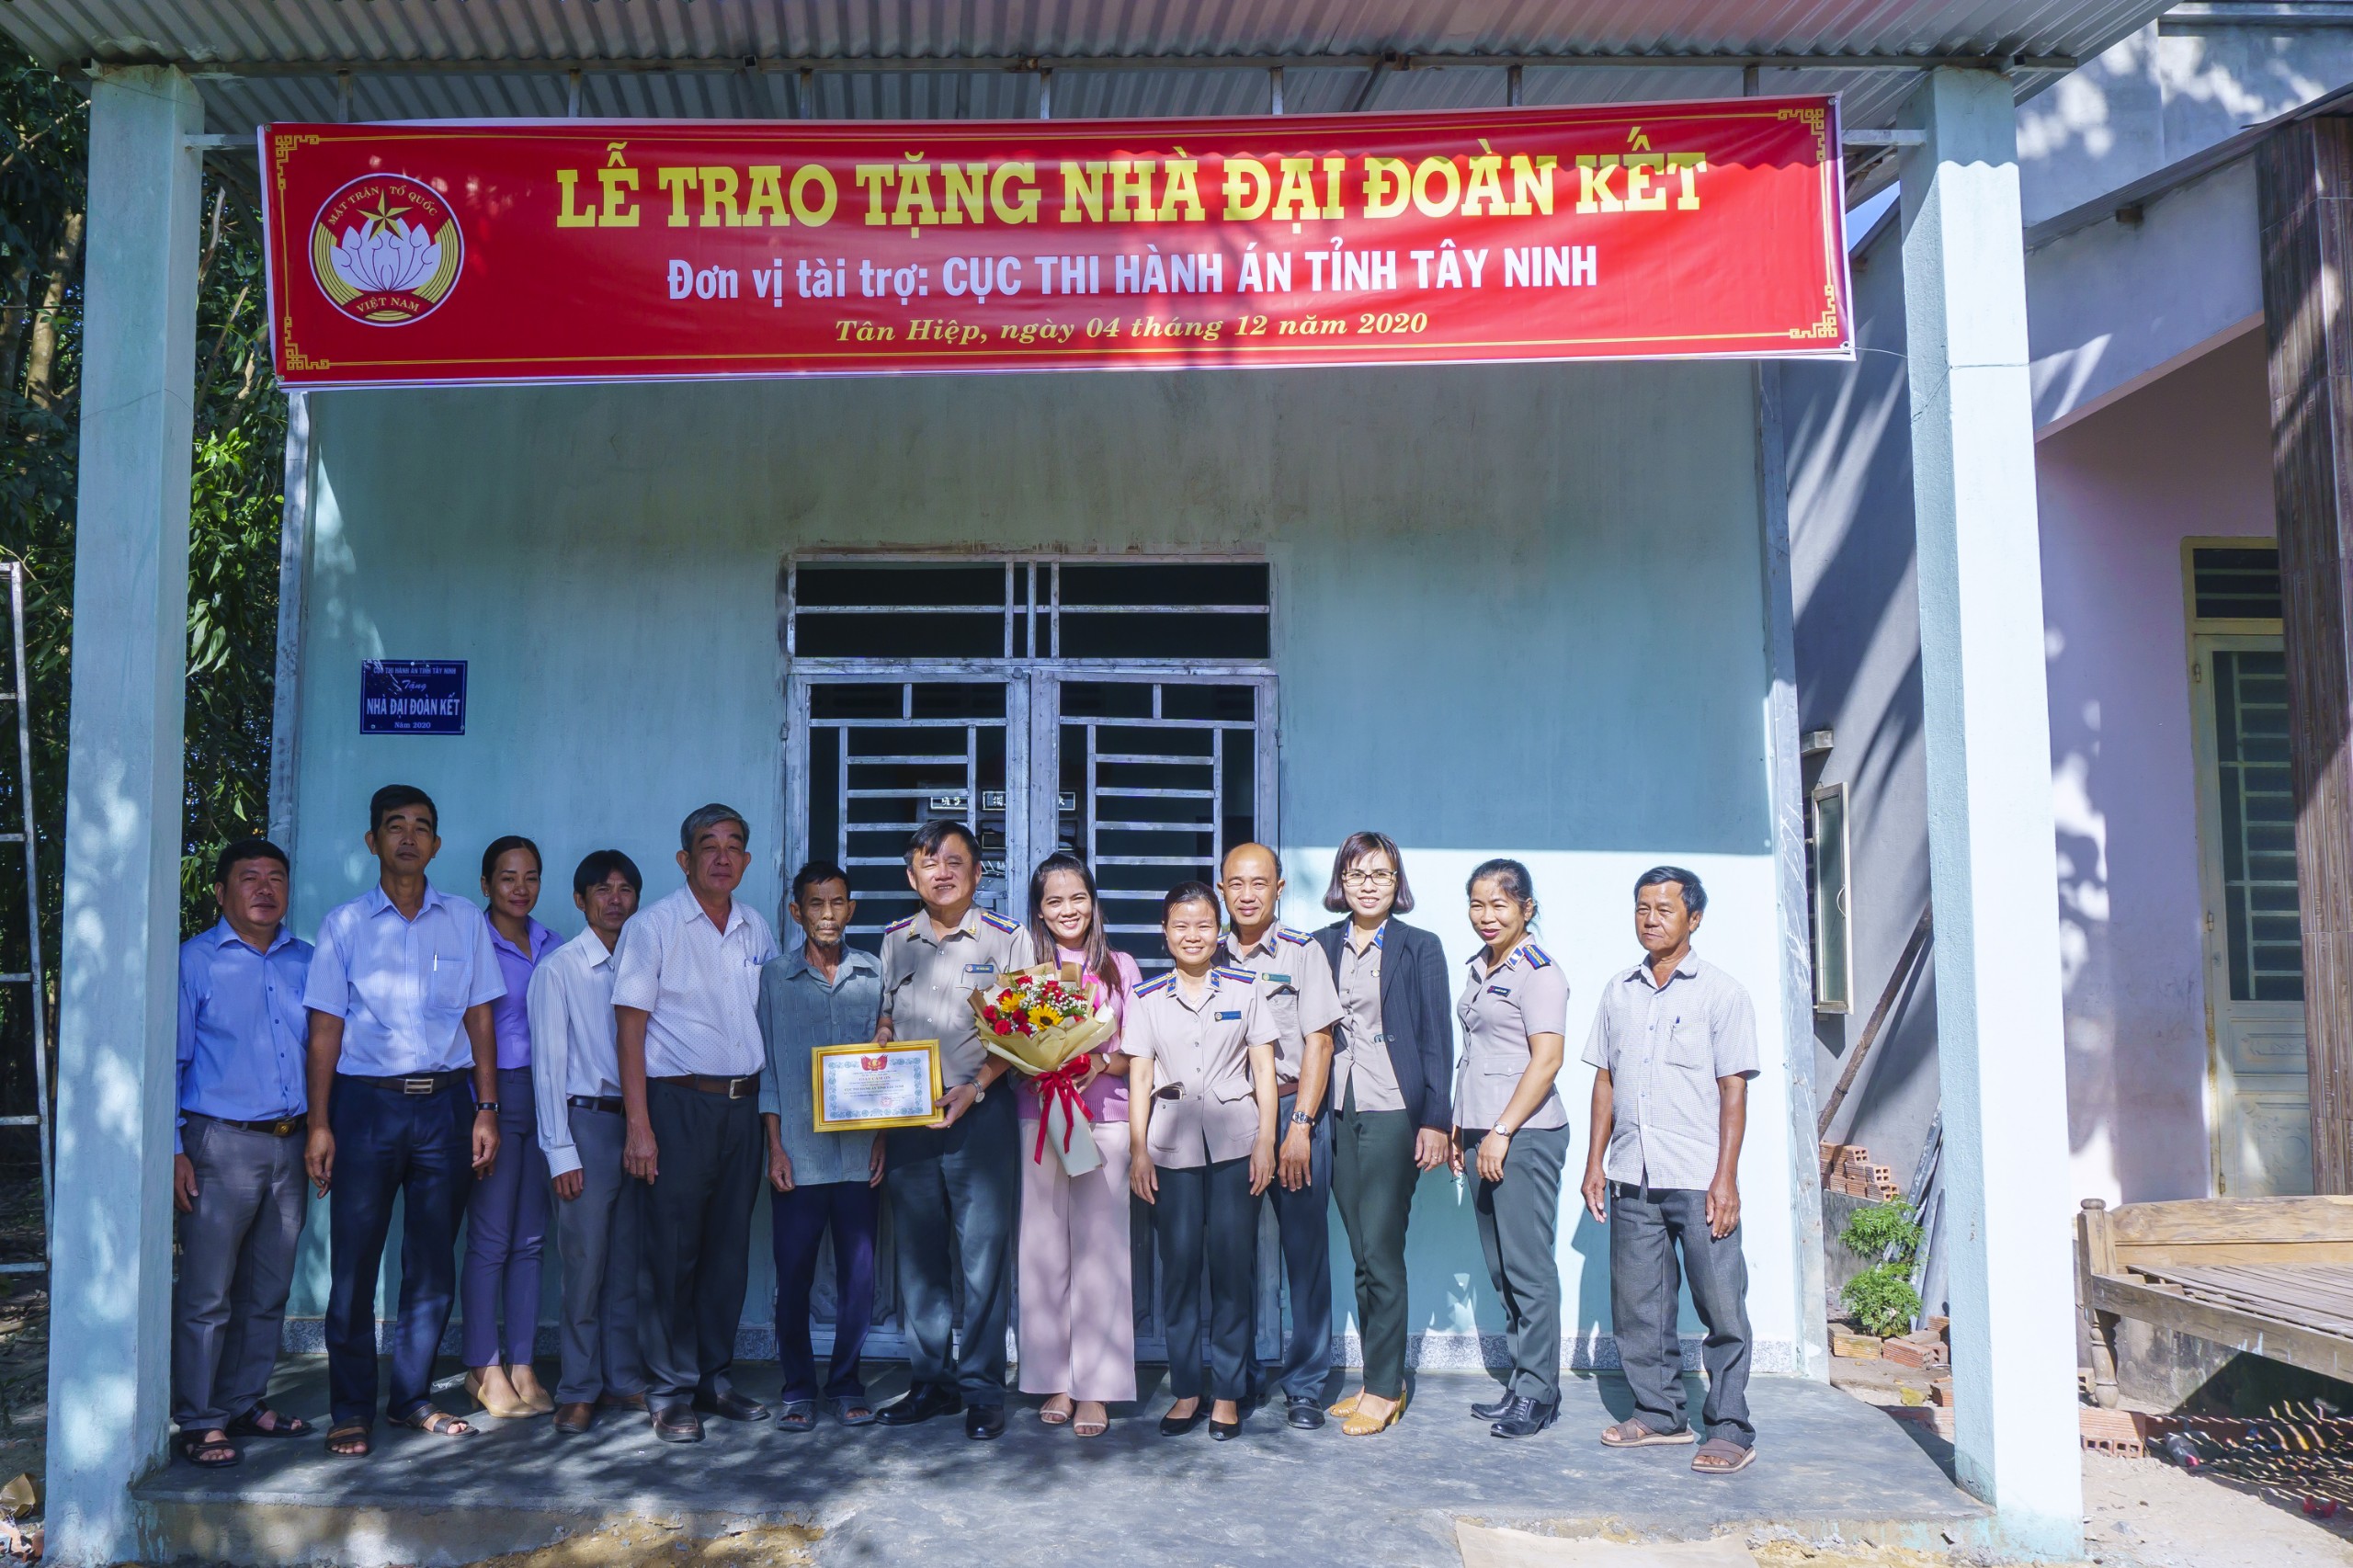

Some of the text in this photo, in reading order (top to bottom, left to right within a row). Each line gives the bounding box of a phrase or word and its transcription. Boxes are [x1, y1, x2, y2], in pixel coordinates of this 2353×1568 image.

[556, 126, 1707, 238] LỄ TRAO TẶNG NHÀ ĐẠI ĐOÀN KẾT
[327, 185, 438, 225] MẶT TRẬN TỔ QUỐC
[666, 235, 1597, 308] Đơn vị tài trợ: CỤC THI HÀNH ÁN TỈNH TÂY NINH
[356, 297, 420, 312] VIỆT NAM
[835, 312, 1428, 346] Tân Hiệp, ngày 04 tháng 12 năm 2020
[402, 679, 427, 692] Tặng
[366, 691, 460, 719] NHÀ ĐẠI ĐOÀN KẾT
